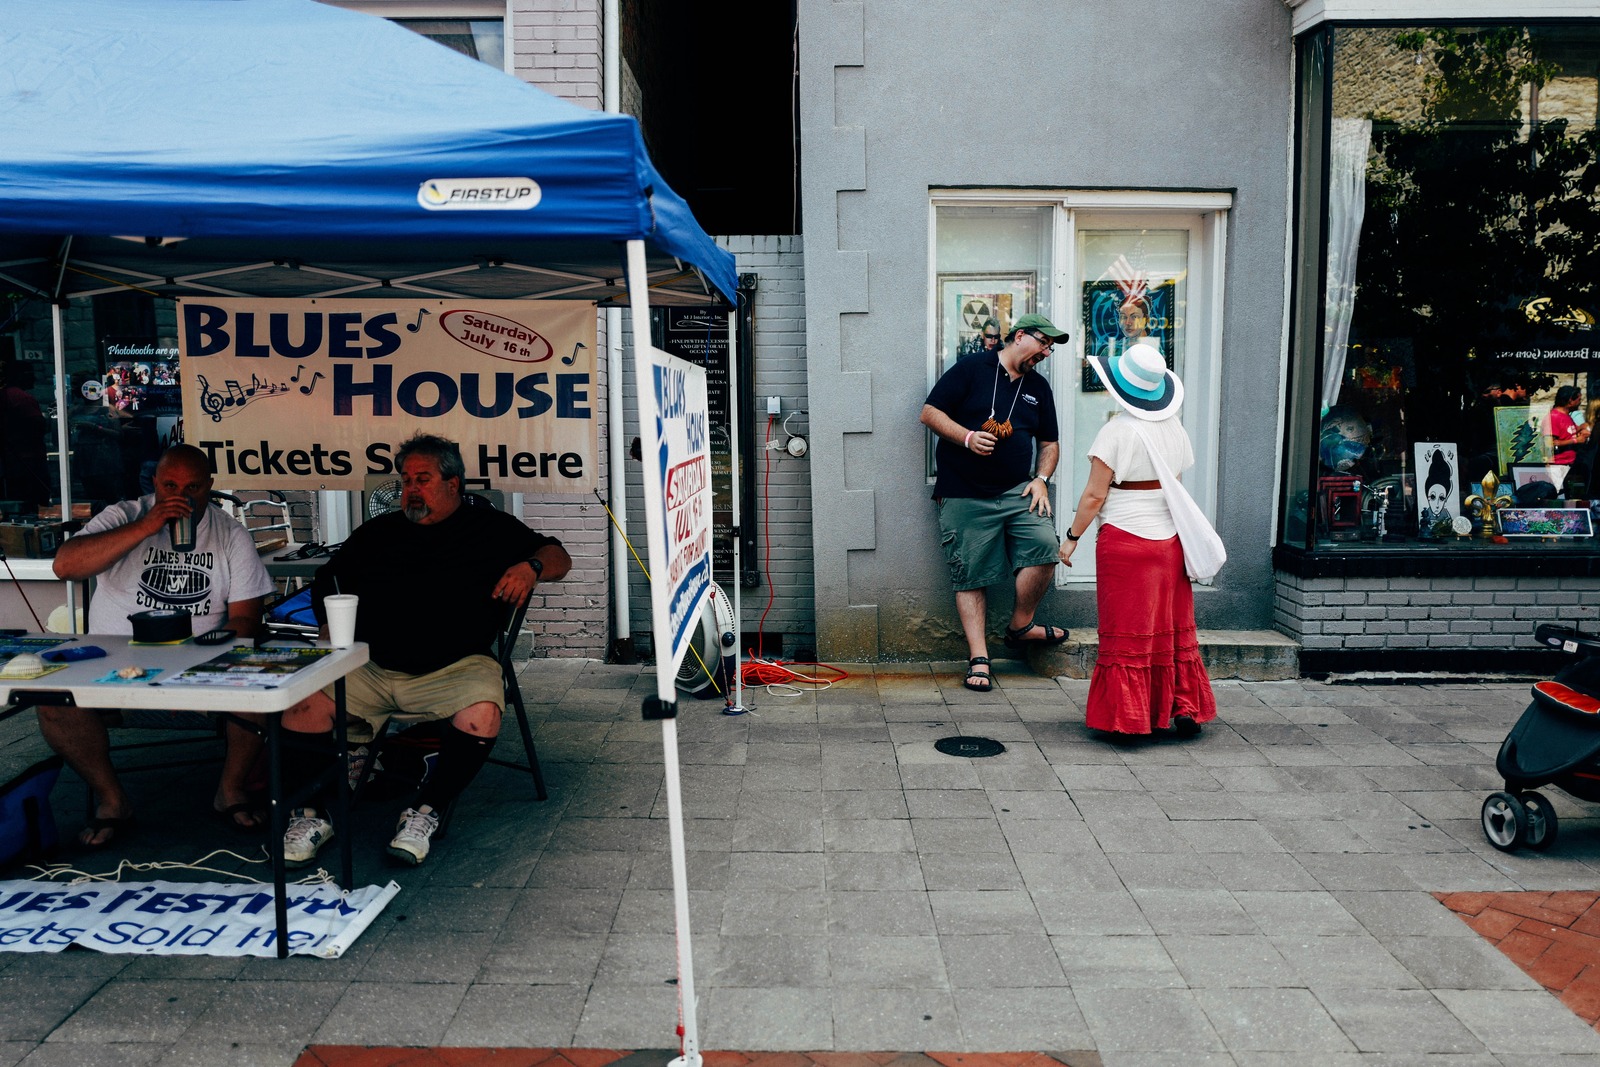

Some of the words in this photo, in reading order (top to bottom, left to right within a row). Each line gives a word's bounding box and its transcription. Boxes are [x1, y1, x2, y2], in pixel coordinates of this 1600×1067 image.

[183, 304, 402, 358] BLUES
[460, 329, 496, 349] July
[503, 341, 517, 354] 16
[462, 314, 538, 345] Saturday
[107, 343, 155, 356] Photobooths
[332, 362, 592, 419] HOUSE
[199, 440, 353, 476] Tickets
[478, 443, 584, 479] Here
[143, 546, 180, 566] JAMES
[184, 551, 214, 570] WOOD
[99, 886, 373, 917] FESTIVA
[93, 921, 229, 947] Sold
